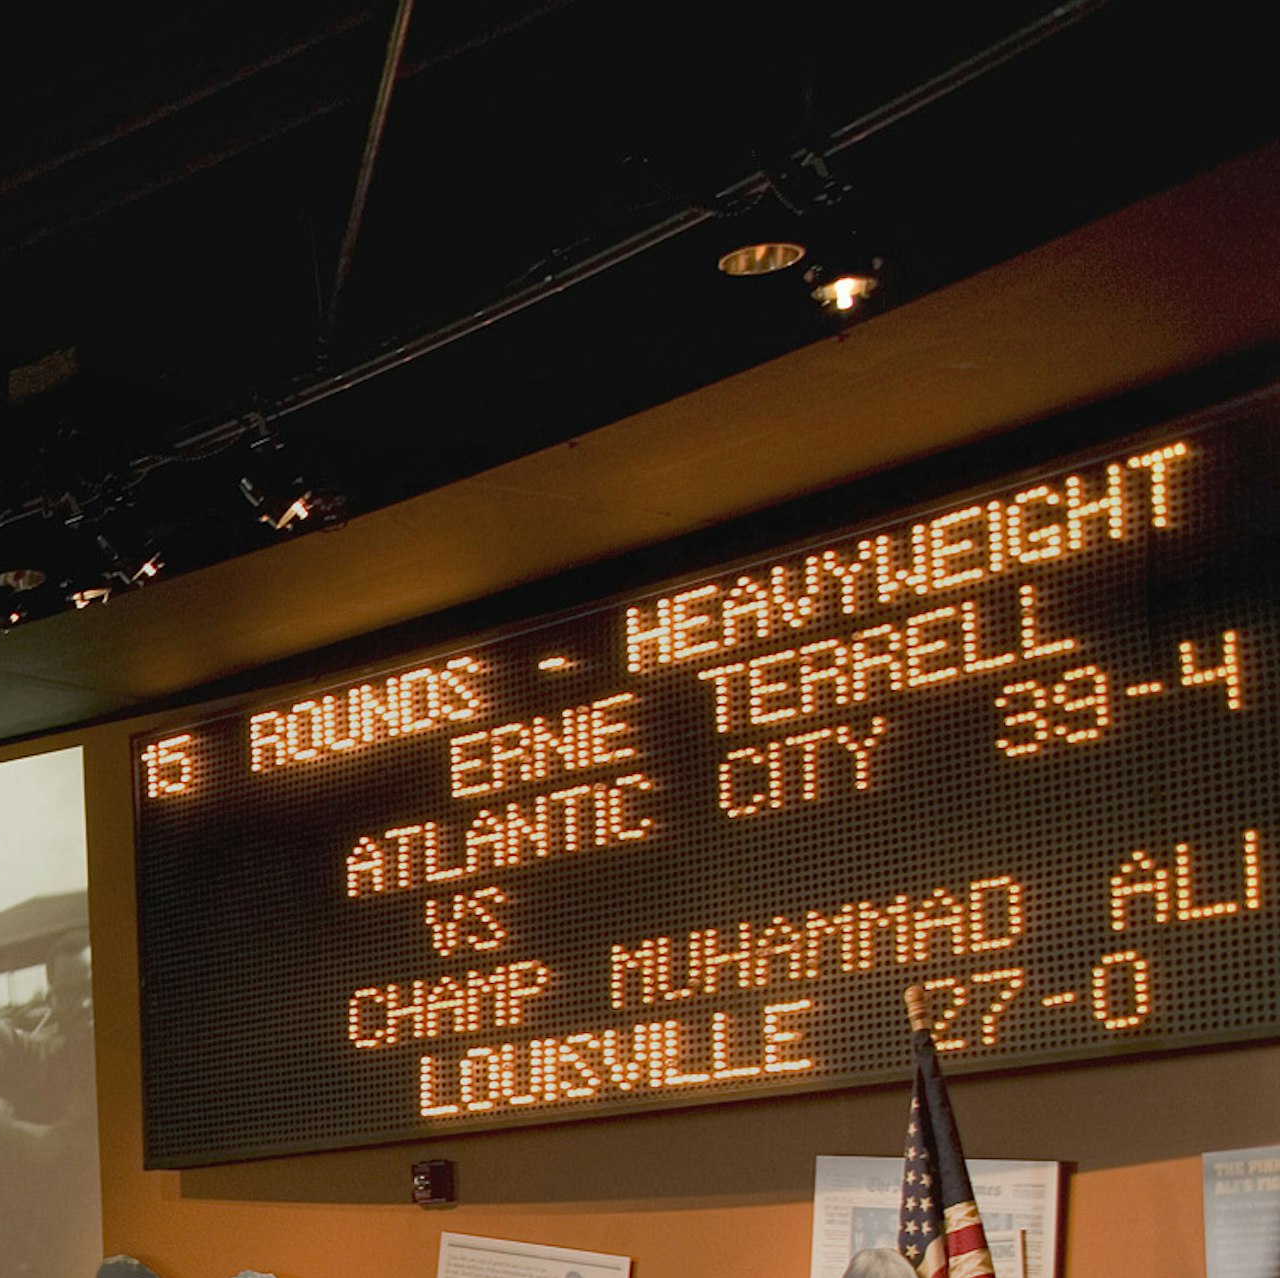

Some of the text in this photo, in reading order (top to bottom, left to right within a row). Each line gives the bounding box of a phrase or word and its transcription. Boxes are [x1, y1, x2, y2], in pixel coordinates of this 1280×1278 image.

[141, 735, 191, 797] 15
[251, 657, 482, 771] ROUNDS
[627, 442, 1186, 671] HEAVYWEIGHT
[451, 585, 1073, 798] ERNIE TERRELL
[346, 630, 1243, 896] ATLANTIC CITY 39-4
[348, 829, 1259, 1048] CHAMP MUHAMMAD ALI
[426, 887, 505, 956] VS
[420, 950, 1148, 1116] LOUISVILLE 27-0
